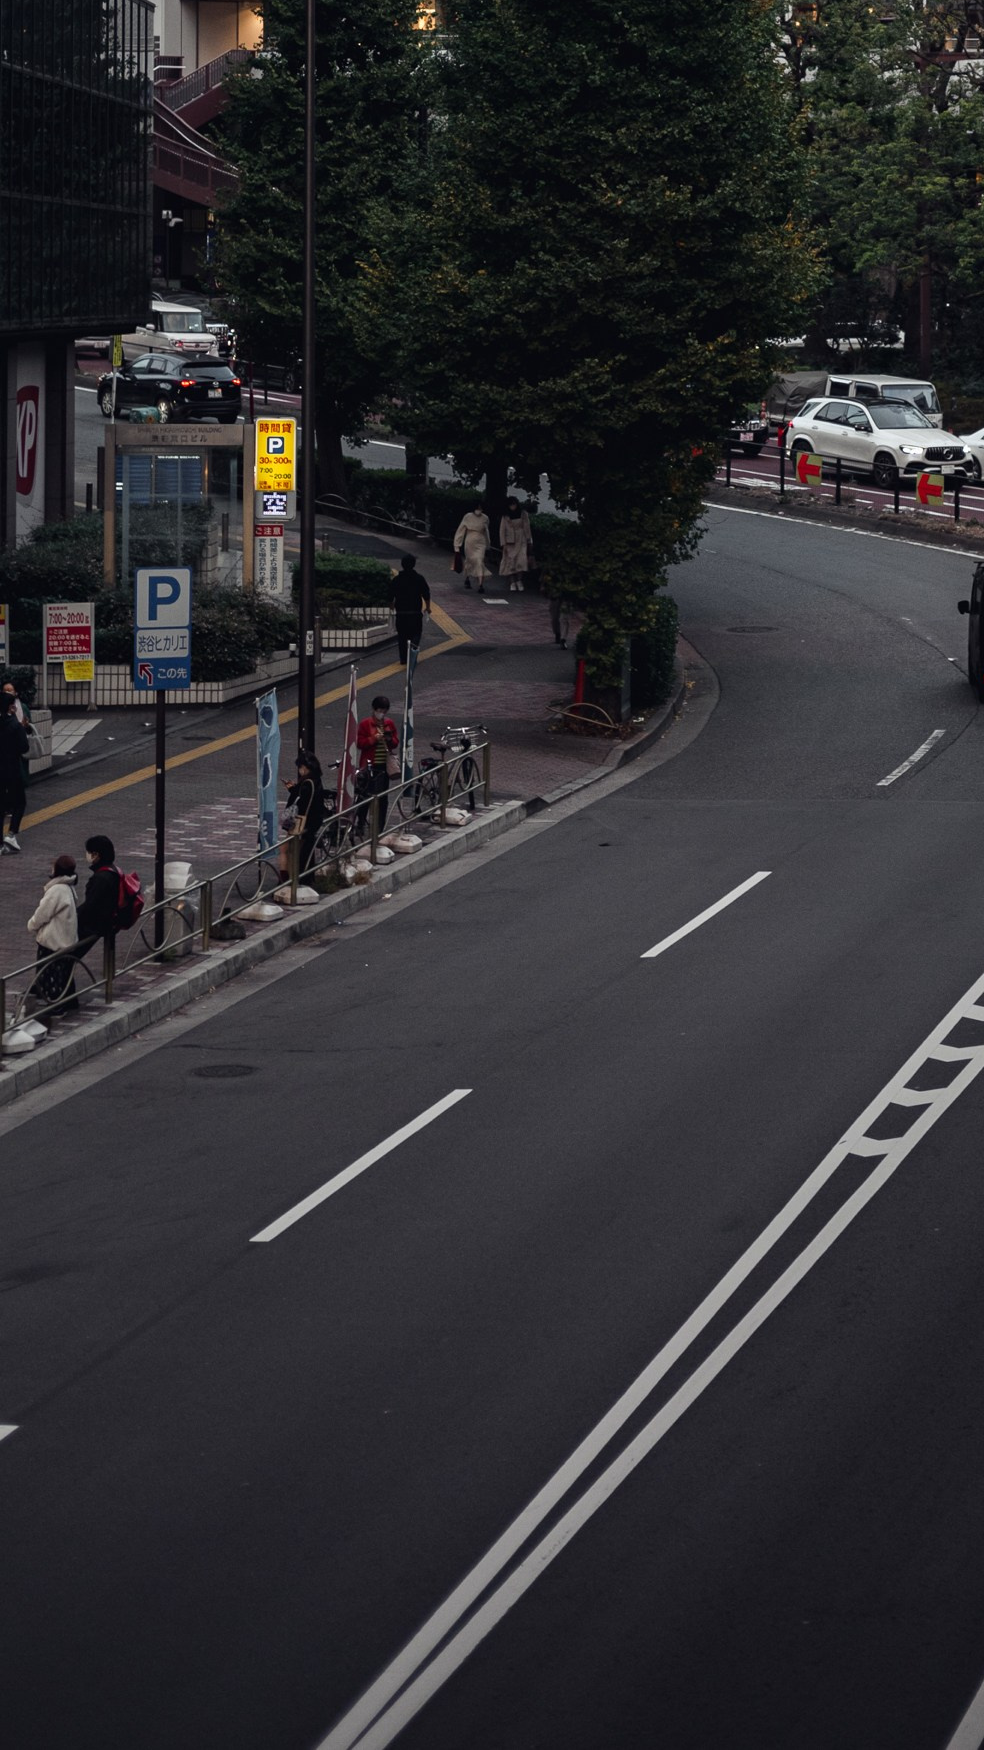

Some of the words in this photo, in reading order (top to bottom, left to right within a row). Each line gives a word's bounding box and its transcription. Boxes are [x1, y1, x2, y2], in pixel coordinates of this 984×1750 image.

[259, 423, 292, 433] 時間貸
[268, 437, 283, 453] P
[255, 527, 281, 536] ご注意
[148, 576, 181, 620] P
[138, 635, 187, 652] 渋谷ヒカリエ
[157, 668, 188, 680] この先
